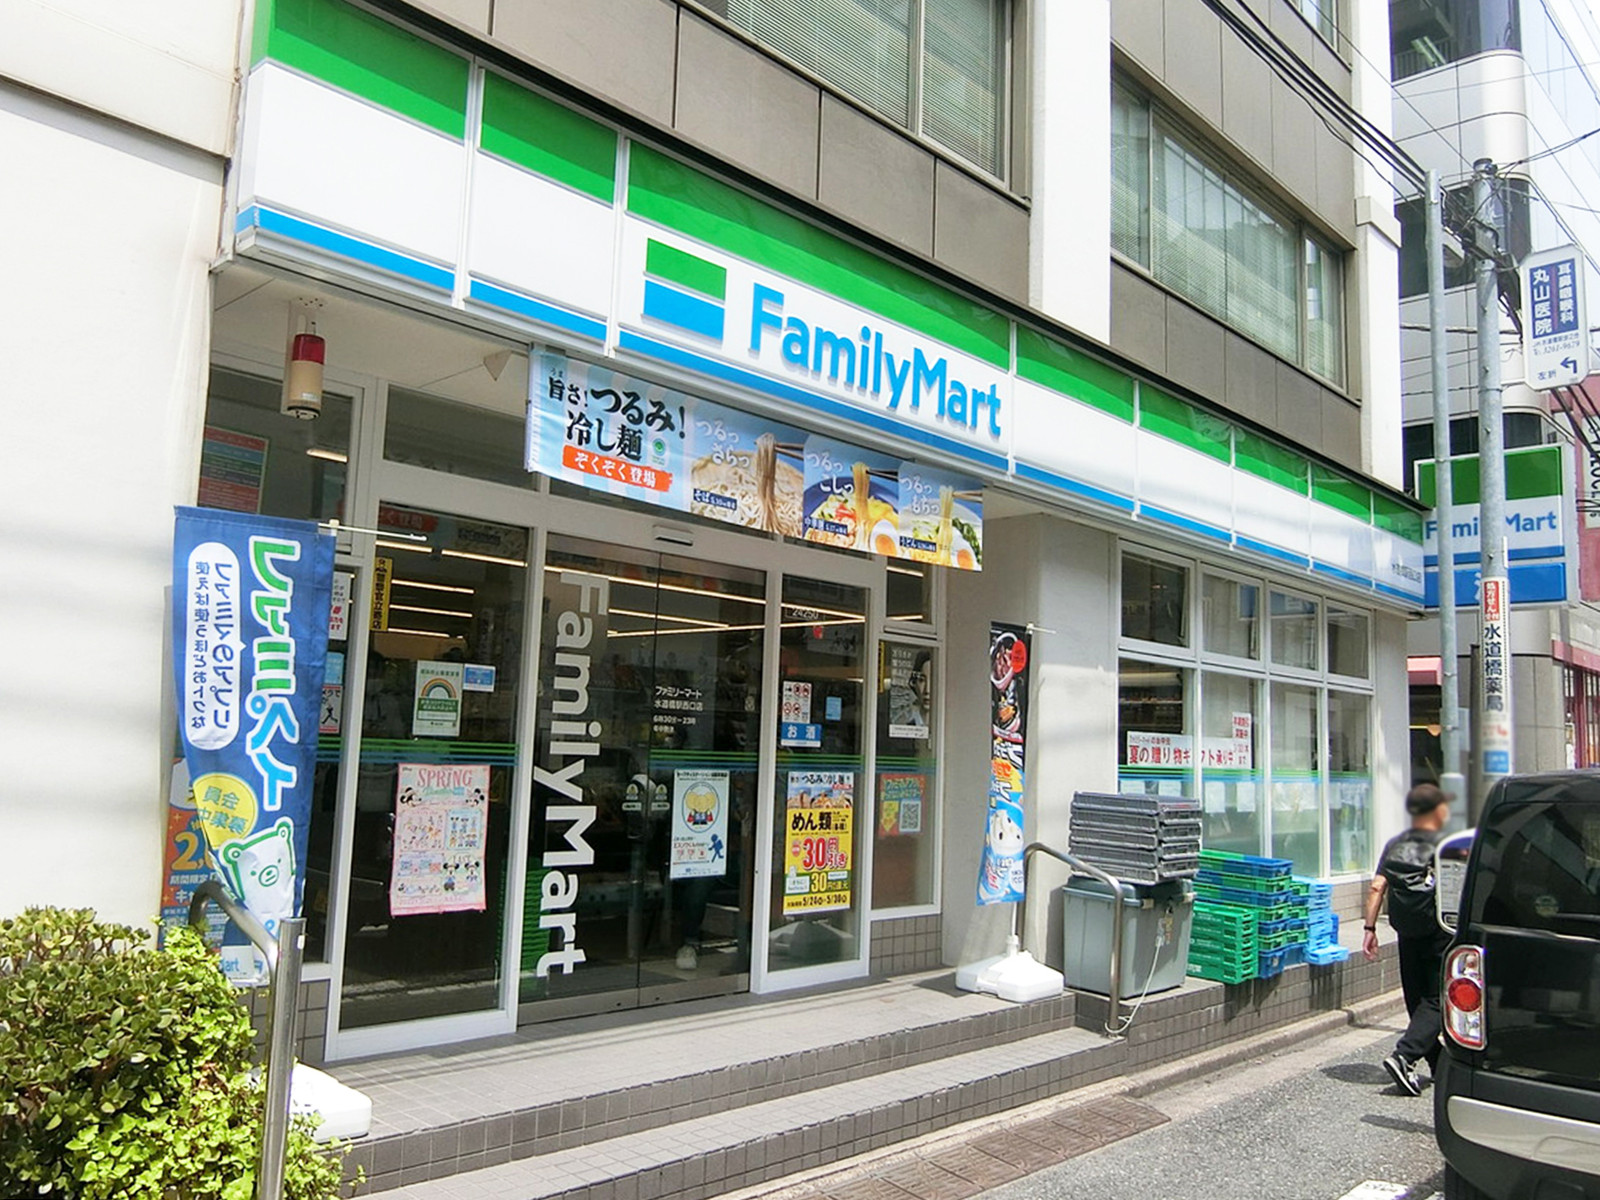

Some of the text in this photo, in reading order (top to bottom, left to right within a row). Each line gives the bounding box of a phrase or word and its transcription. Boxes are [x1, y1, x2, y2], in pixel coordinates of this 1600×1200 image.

[1533, 269, 1552, 335] 丸山医院
[749, 283, 1001, 437] FamilyMart
[567, 410, 642, 461] 冷し麺
[696, 419, 739, 443] つるっ
[712, 442, 749, 467] さらっ
[806, 452, 844, 472] つるっ
[574, 452, 656, 487] ぞくぞく登場
[820, 473, 854, 494] こしっ
[900, 475, 932, 494] つるっ
[1425, 511, 1557, 540] FmiMart
[1485, 624, 1503, 712] 水道橋薬局
[655, 686, 703, 699] ファミリーマート
[532, 573, 609, 977] FamilyMart
[792, 812, 832, 832] めん類
[802, 837, 828, 871] 30
[811, 872, 827, 892] 30
